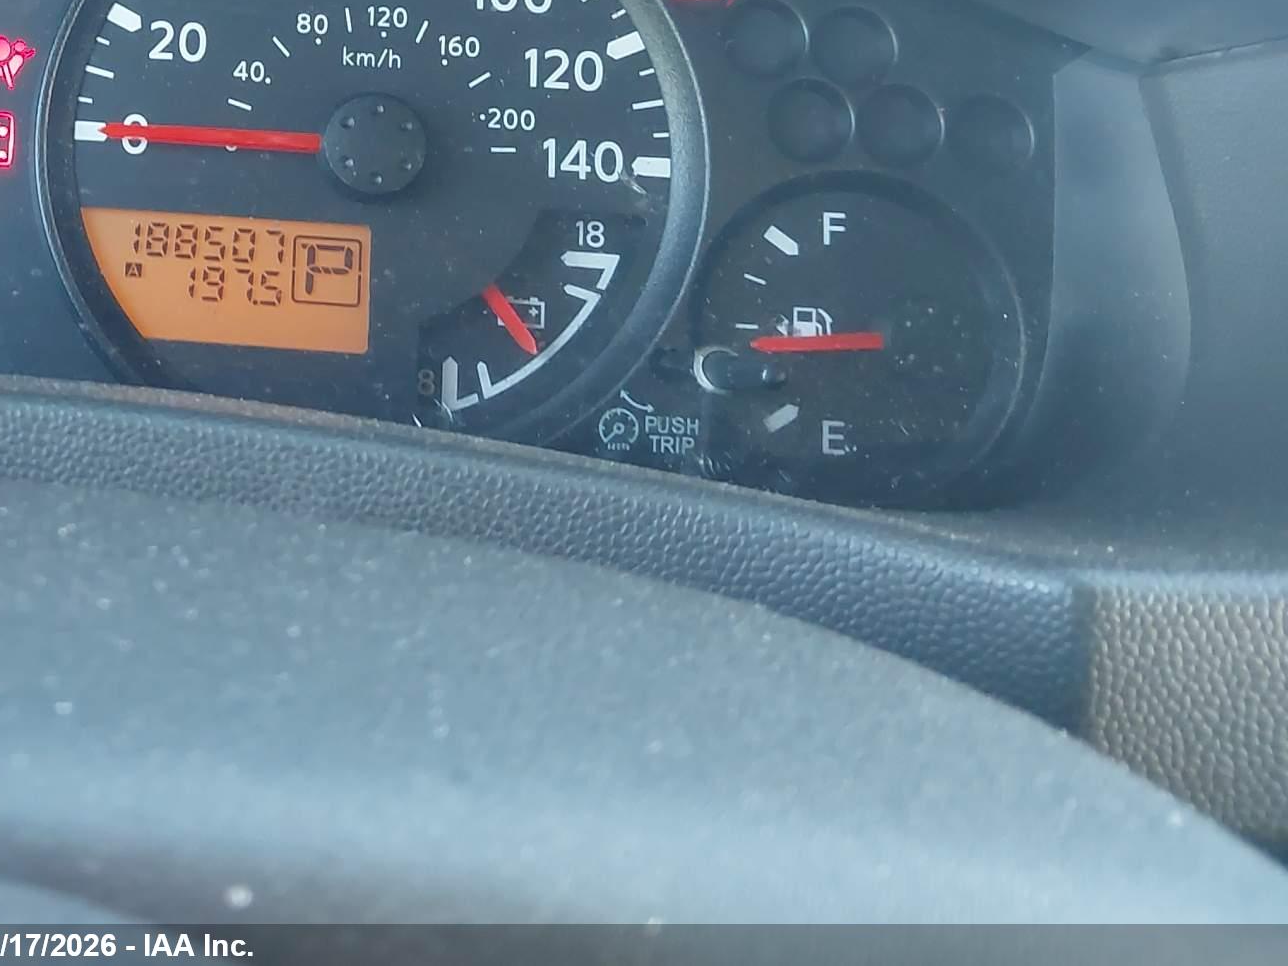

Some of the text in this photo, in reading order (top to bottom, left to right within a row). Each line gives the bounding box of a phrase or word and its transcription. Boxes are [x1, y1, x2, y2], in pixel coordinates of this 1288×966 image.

[296, 13, 329, 35] 80
[367, 6, 409, 29] 120
[148, 20, 207, 63] 20
[438, 35, 480, 58] 160
[342, 46, 402, 70] km/h
[524, 48, 604, 91] 120
[121, 113, 149, 155] 0
[486, 107, 536, 131] 200
[542, 138, 624, 183] 140
[132, 221, 285, 264] 188507
[575, 220, 605, 247] 18
[822, 211, 846, 246] F
[301, 242, 354, 296] P
[188, 265, 282, 307] 197.5
[417, 369, 436, 397] 8
[644, 415, 700, 435] PUSH
[821, 420, 846, 456] E
[649, 435, 696, 454] TRIP
